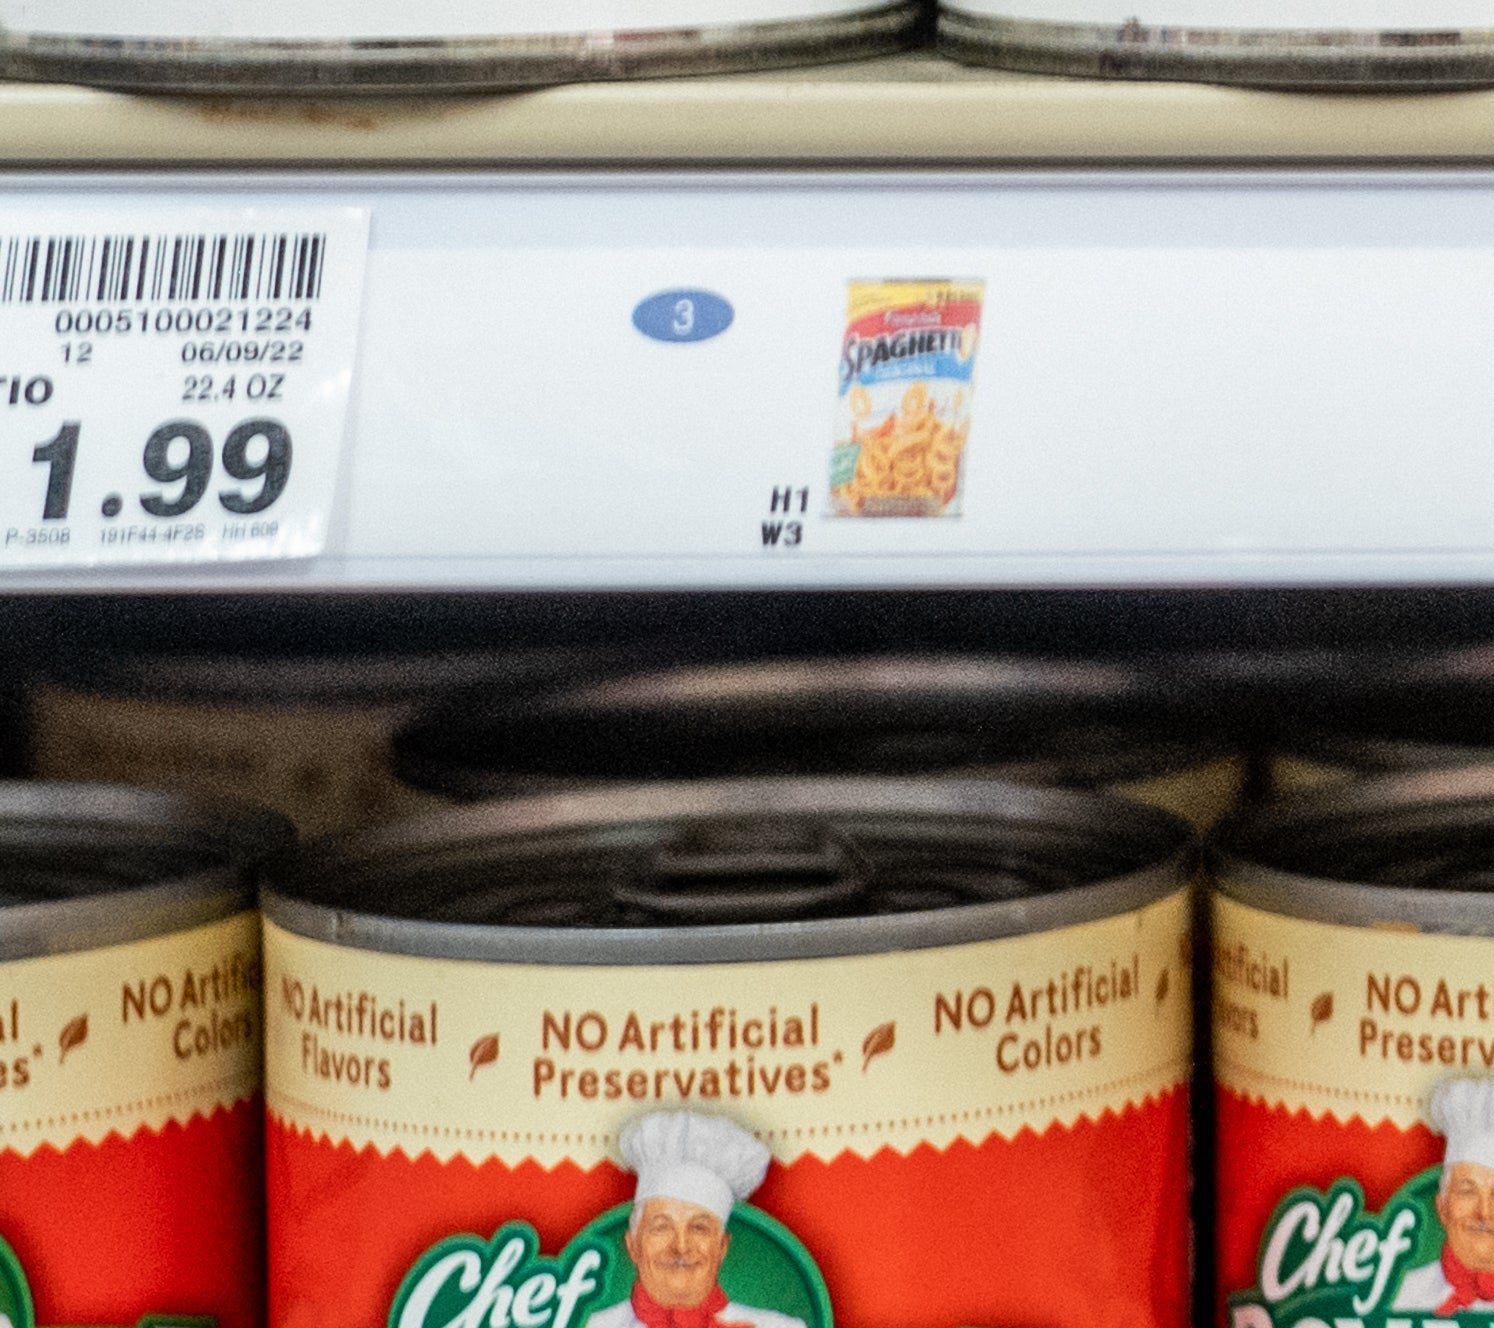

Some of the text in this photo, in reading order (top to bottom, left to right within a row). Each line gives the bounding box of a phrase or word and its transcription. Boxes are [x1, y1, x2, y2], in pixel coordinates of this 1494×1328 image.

[55, 308, 311, 334] 0005100021224
[672, 298, 694, 335] 3
[63, 342, 303, 364] 12 06/09/22
[182, 374, 285, 402] 22.4 OZ
[32, 419, 292, 521] 1.99
[304, 985, 437, 1050] Artificial
[935, 956, 1140, 1034] NO Artificial
[1366, 973, 1421, 1016] NO
[542, 1003, 818, 1053] NO Artificial
[996, 1023, 1102, 1074] Colors
[303, 1032, 391, 1090] Flavors
[1260, 1192, 1416, 1316] Chef
[396, 1235, 601, 1328] Chef
